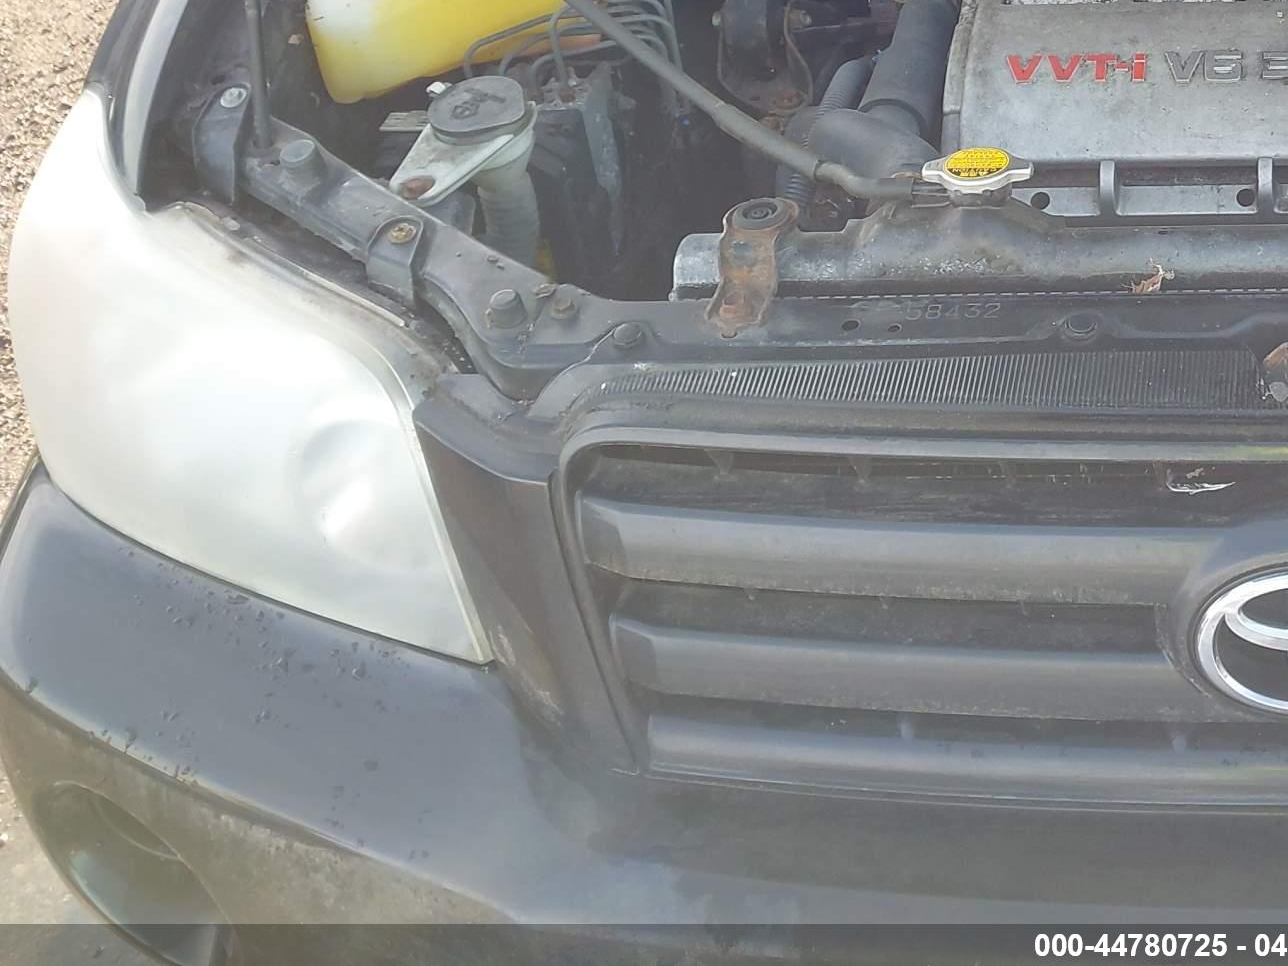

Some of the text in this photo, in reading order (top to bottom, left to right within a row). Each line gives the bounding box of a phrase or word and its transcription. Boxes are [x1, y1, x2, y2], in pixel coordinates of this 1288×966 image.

[1006, 51, 1148, 83] VVT-i
[1164, 50, 1243, 82] V6
[904, 300, 1001, 321] 58432
